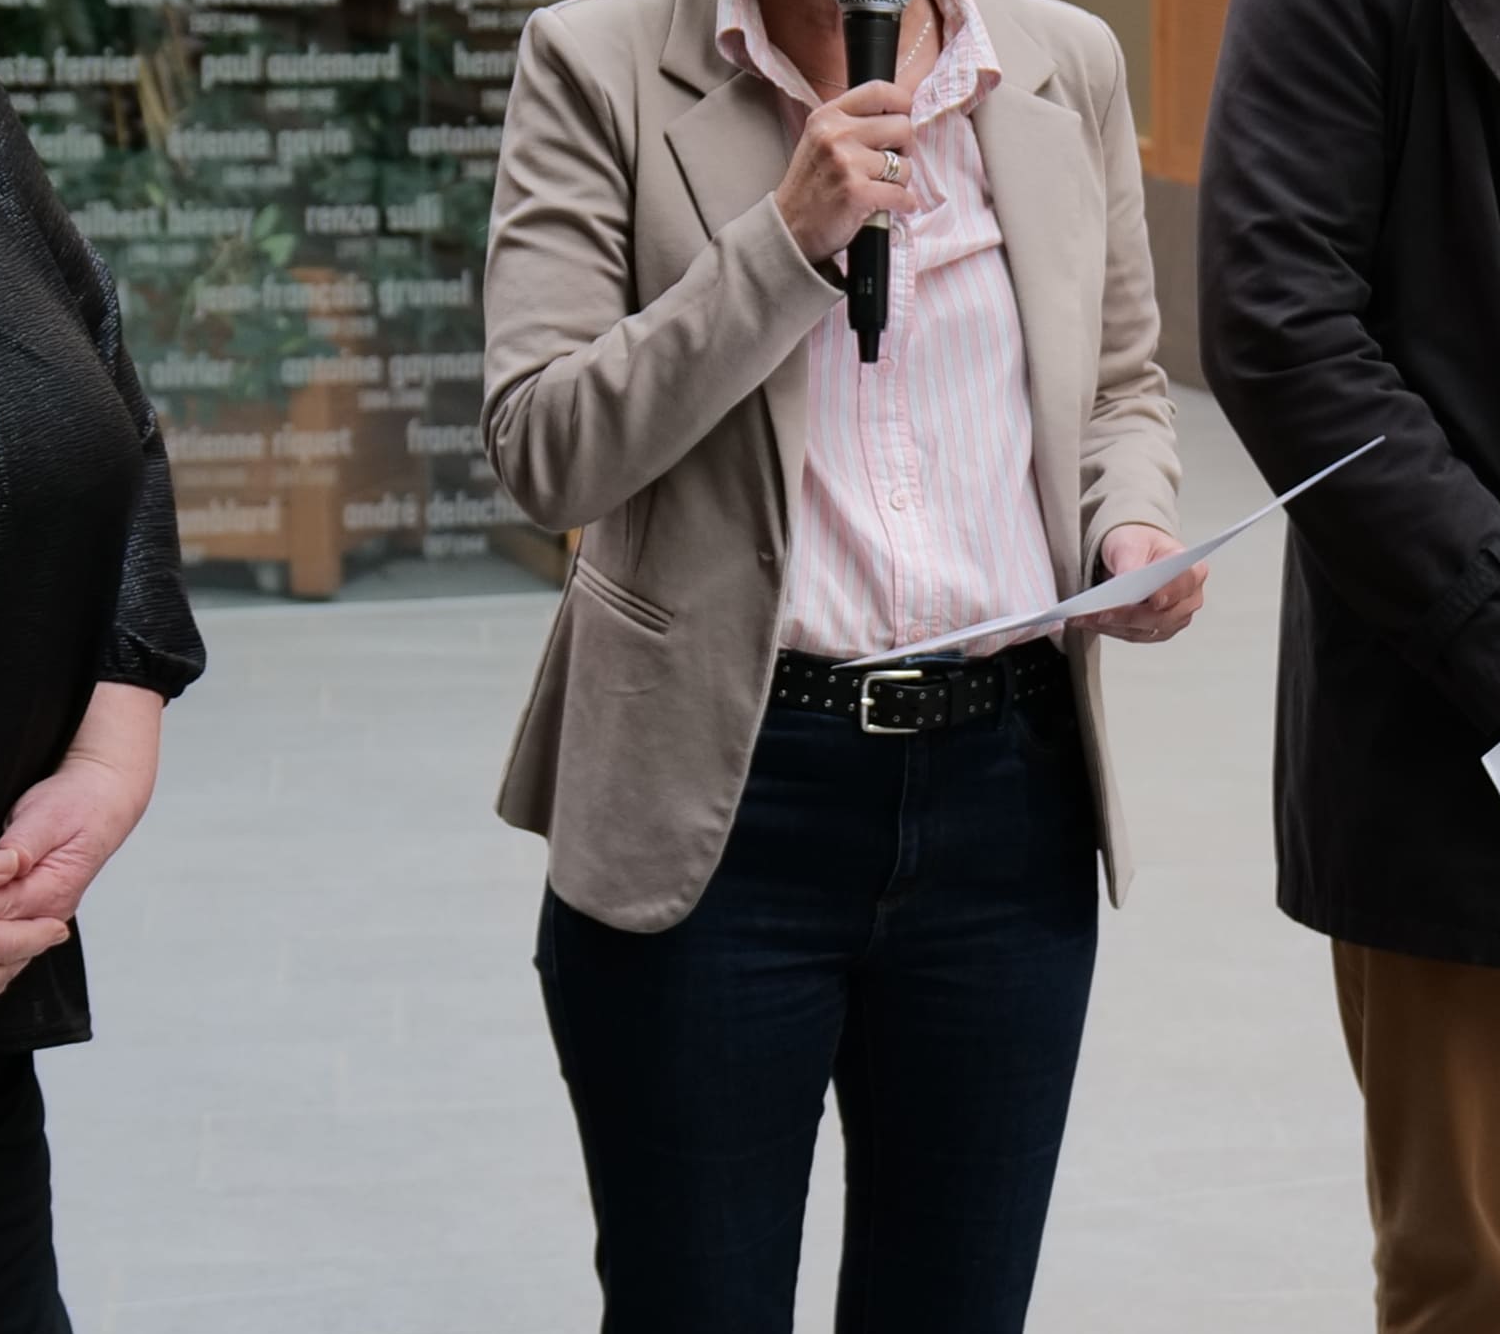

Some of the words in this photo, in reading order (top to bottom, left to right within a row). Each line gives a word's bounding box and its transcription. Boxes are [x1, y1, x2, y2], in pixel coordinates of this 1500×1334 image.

[52, 45, 143, 86] ferrier
[201, 43, 262, 91] paul
[266, 42, 399, 83] audemard
[165, 120, 271, 159] étienne
[276, 119, 352, 168] gavin
[304, 205, 381, 234] renzo
[386, 192, 444, 233] sulli
[377, 269, 476, 316] grumel
[150, 350, 236, 388] olivier
[280, 346, 384, 386] antoine
[164, 425, 264, 461] étienne
[271, 422, 354, 465] riquet
[175, 495, 282, 537] mblard
[342, 491, 419, 530] andré
